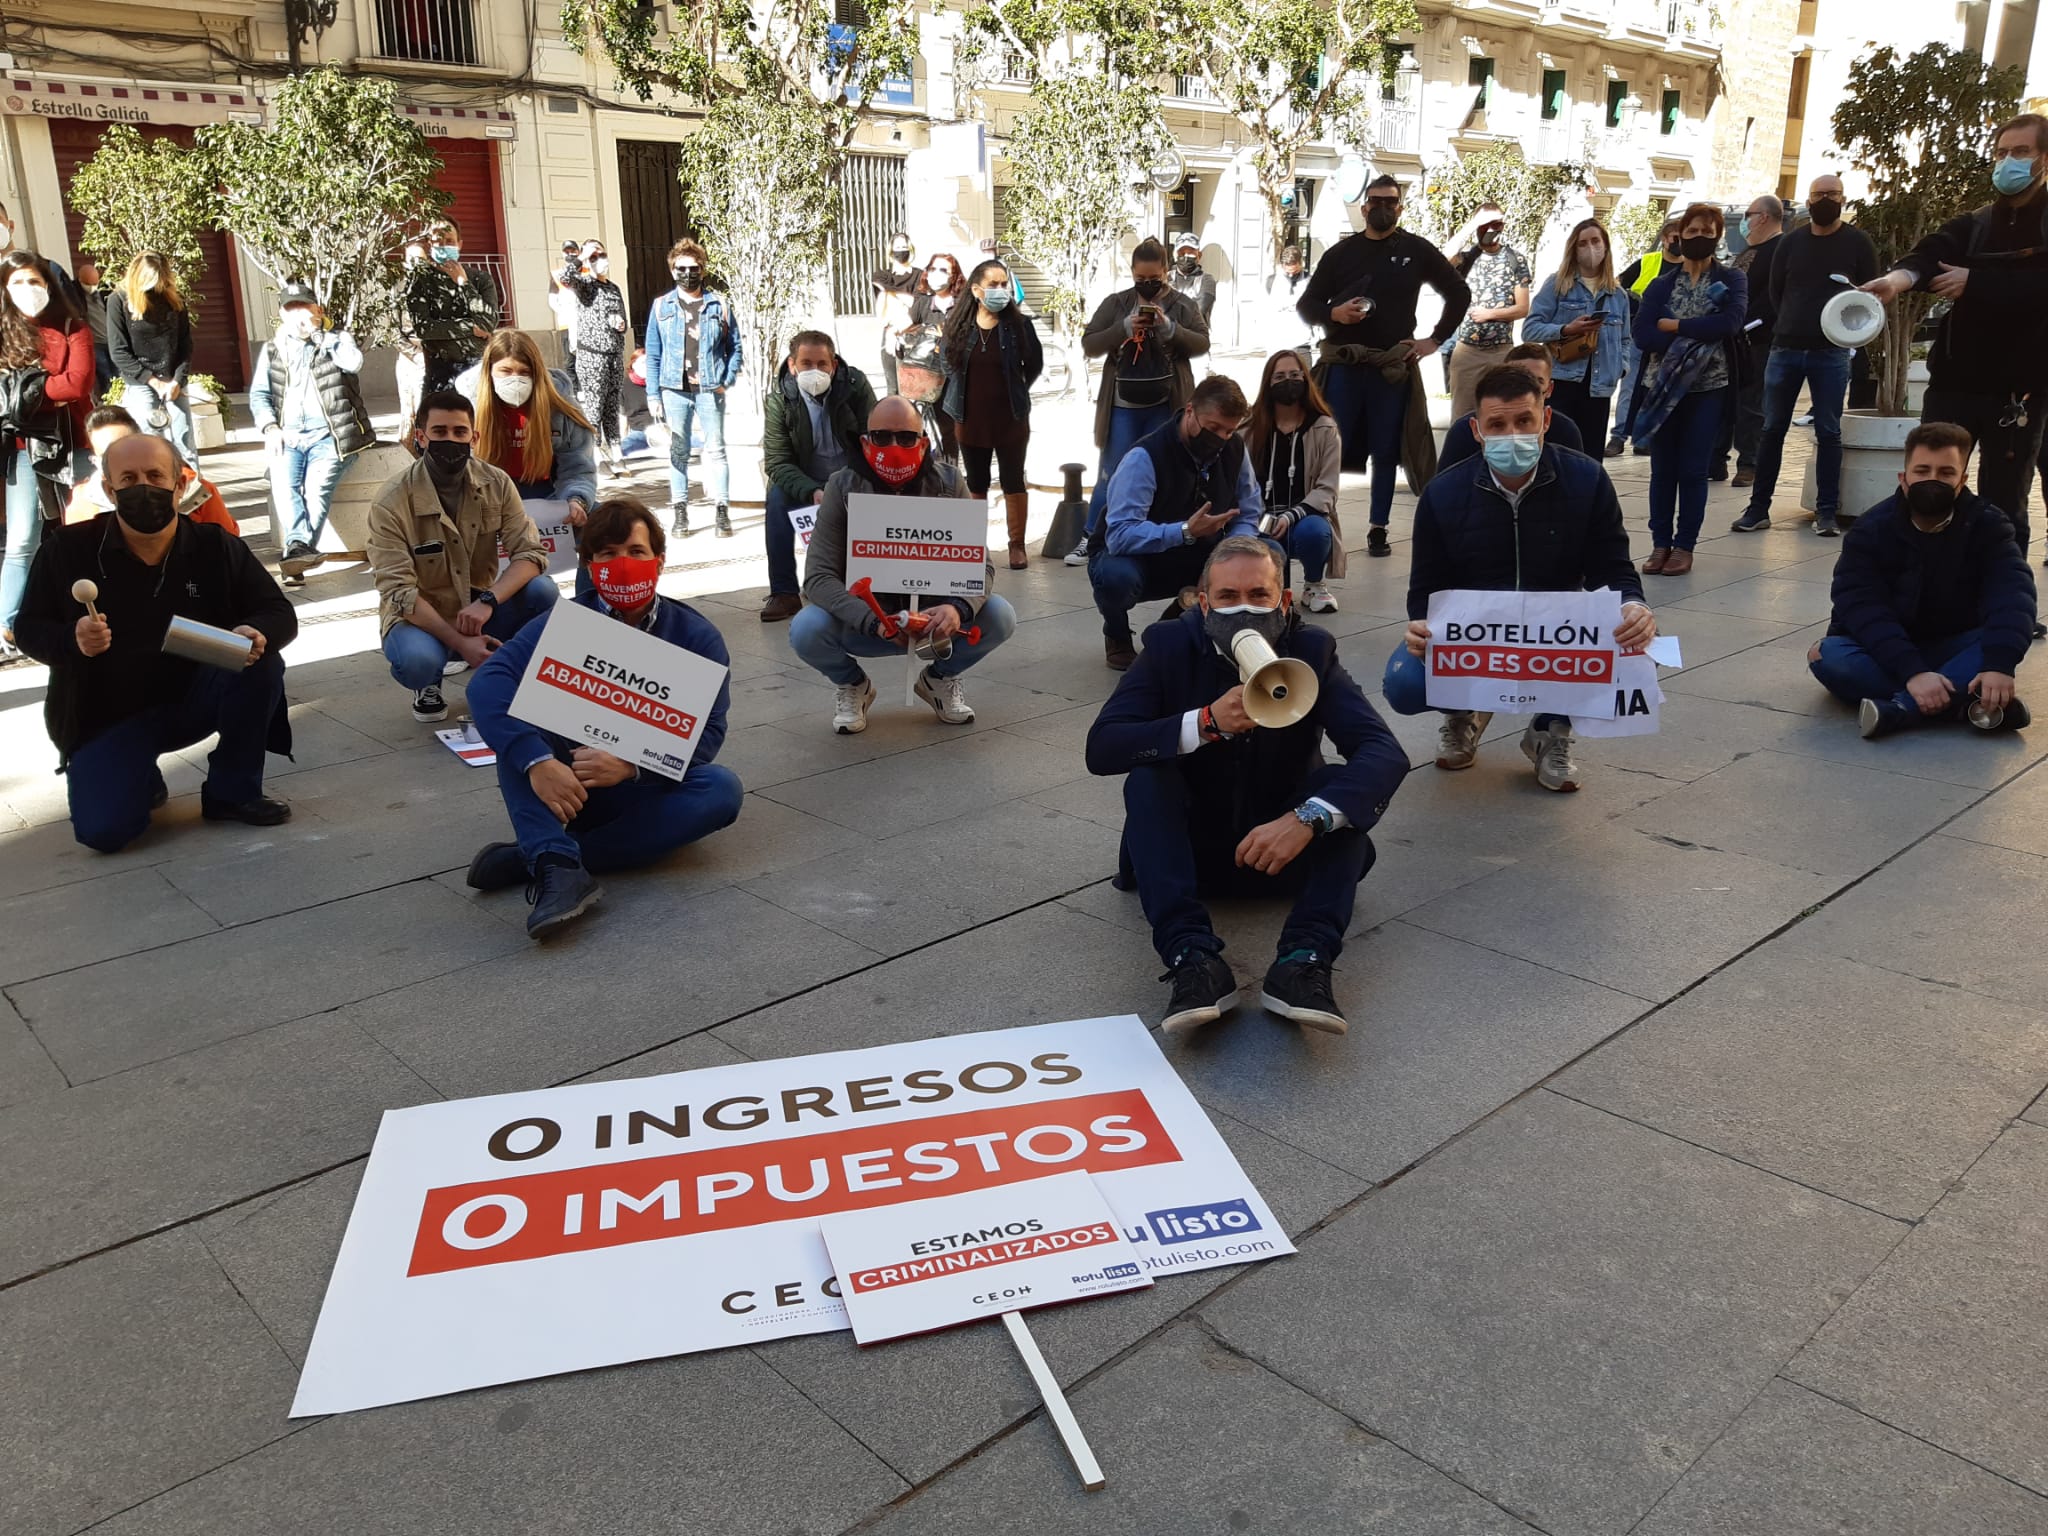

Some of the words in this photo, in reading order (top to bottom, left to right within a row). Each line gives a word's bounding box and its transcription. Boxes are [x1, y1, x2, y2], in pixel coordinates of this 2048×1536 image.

[32, 99, 92, 118] Estrella
[96, 104, 149, 121] Galicia
[416, 122, 448, 135] alicia
[886, 528, 952, 541] ESTAMOS
[855, 542, 981, 560] CRIMINALIZADOS
[600, 567, 609, 581] #
[902, 579, 931, 587] CEOH
[600, 579, 653, 593] SALVEMOSLA
[1446, 619, 1599, 645] BOTELLÓN
[1438, 652, 1481, 670] NO
[1488, 653, 1520, 673] ES
[1528, 656, 1606, 677] OCIO
[583, 654, 671, 700] ESTAMOS
[542, 663, 691, 733] ABANDONADOS
[1500, 695, 1537, 703] CEOH
[584, 724, 620, 744] CEOH
[643, 748, 663, 761] Rotu
[664, 755, 682, 769] listo
[487, 1116, 562, 1162] O
[595, 1053, 1082, 1149] INGRESOS
[442, 1193, 528, 1250] O
[563, 1115, 1148, 1236] IMPUESTOS
[1156, 1211, 1249, 1239] listo
[911, 1218, 1044, 1256] ESTAMOS
[858, 1225, 1110, 1289] CRIMINALIZADOS
[1072, 1270, 1104, 1284] Rotu
[1106, 1265, 1137, 1280] listo
[972, 1285, 1032, 1304] CEOH
